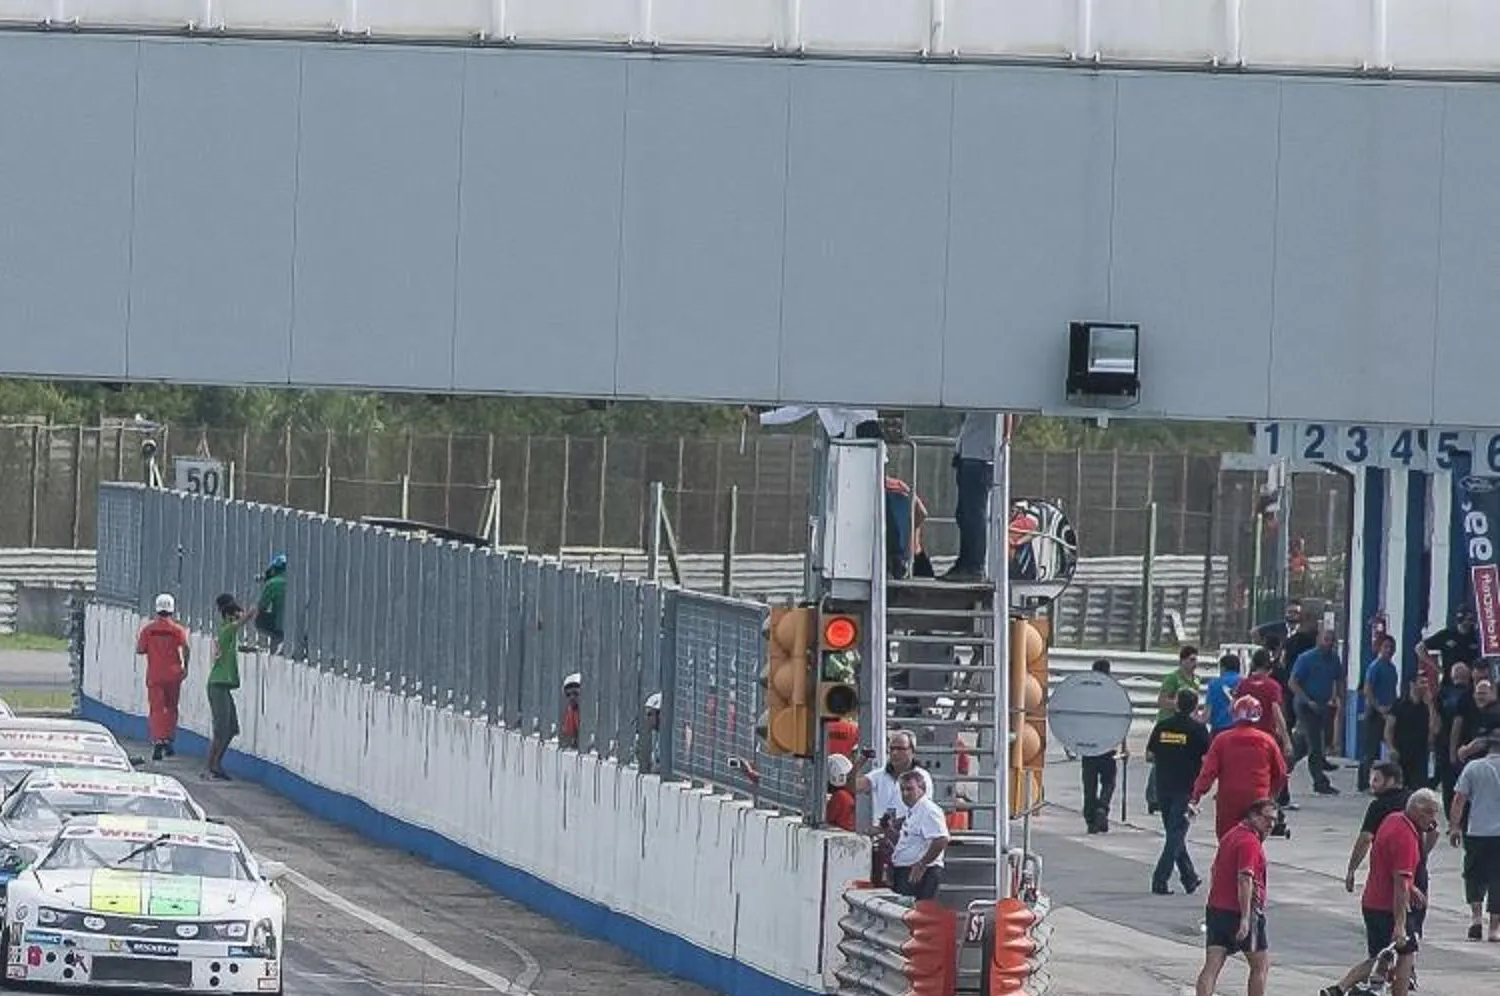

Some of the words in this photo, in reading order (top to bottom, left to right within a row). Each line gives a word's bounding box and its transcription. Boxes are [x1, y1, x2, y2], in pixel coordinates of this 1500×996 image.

[1264, 423, 1279, 454] 1
[1304, 424, 1325, 458] 2
[1346, 426, 1368, 462] 3
[1390, 430, 1413, 464] 4
[1436, 432, 1459, 469] 5
[187, 467, 219, 494] 50
